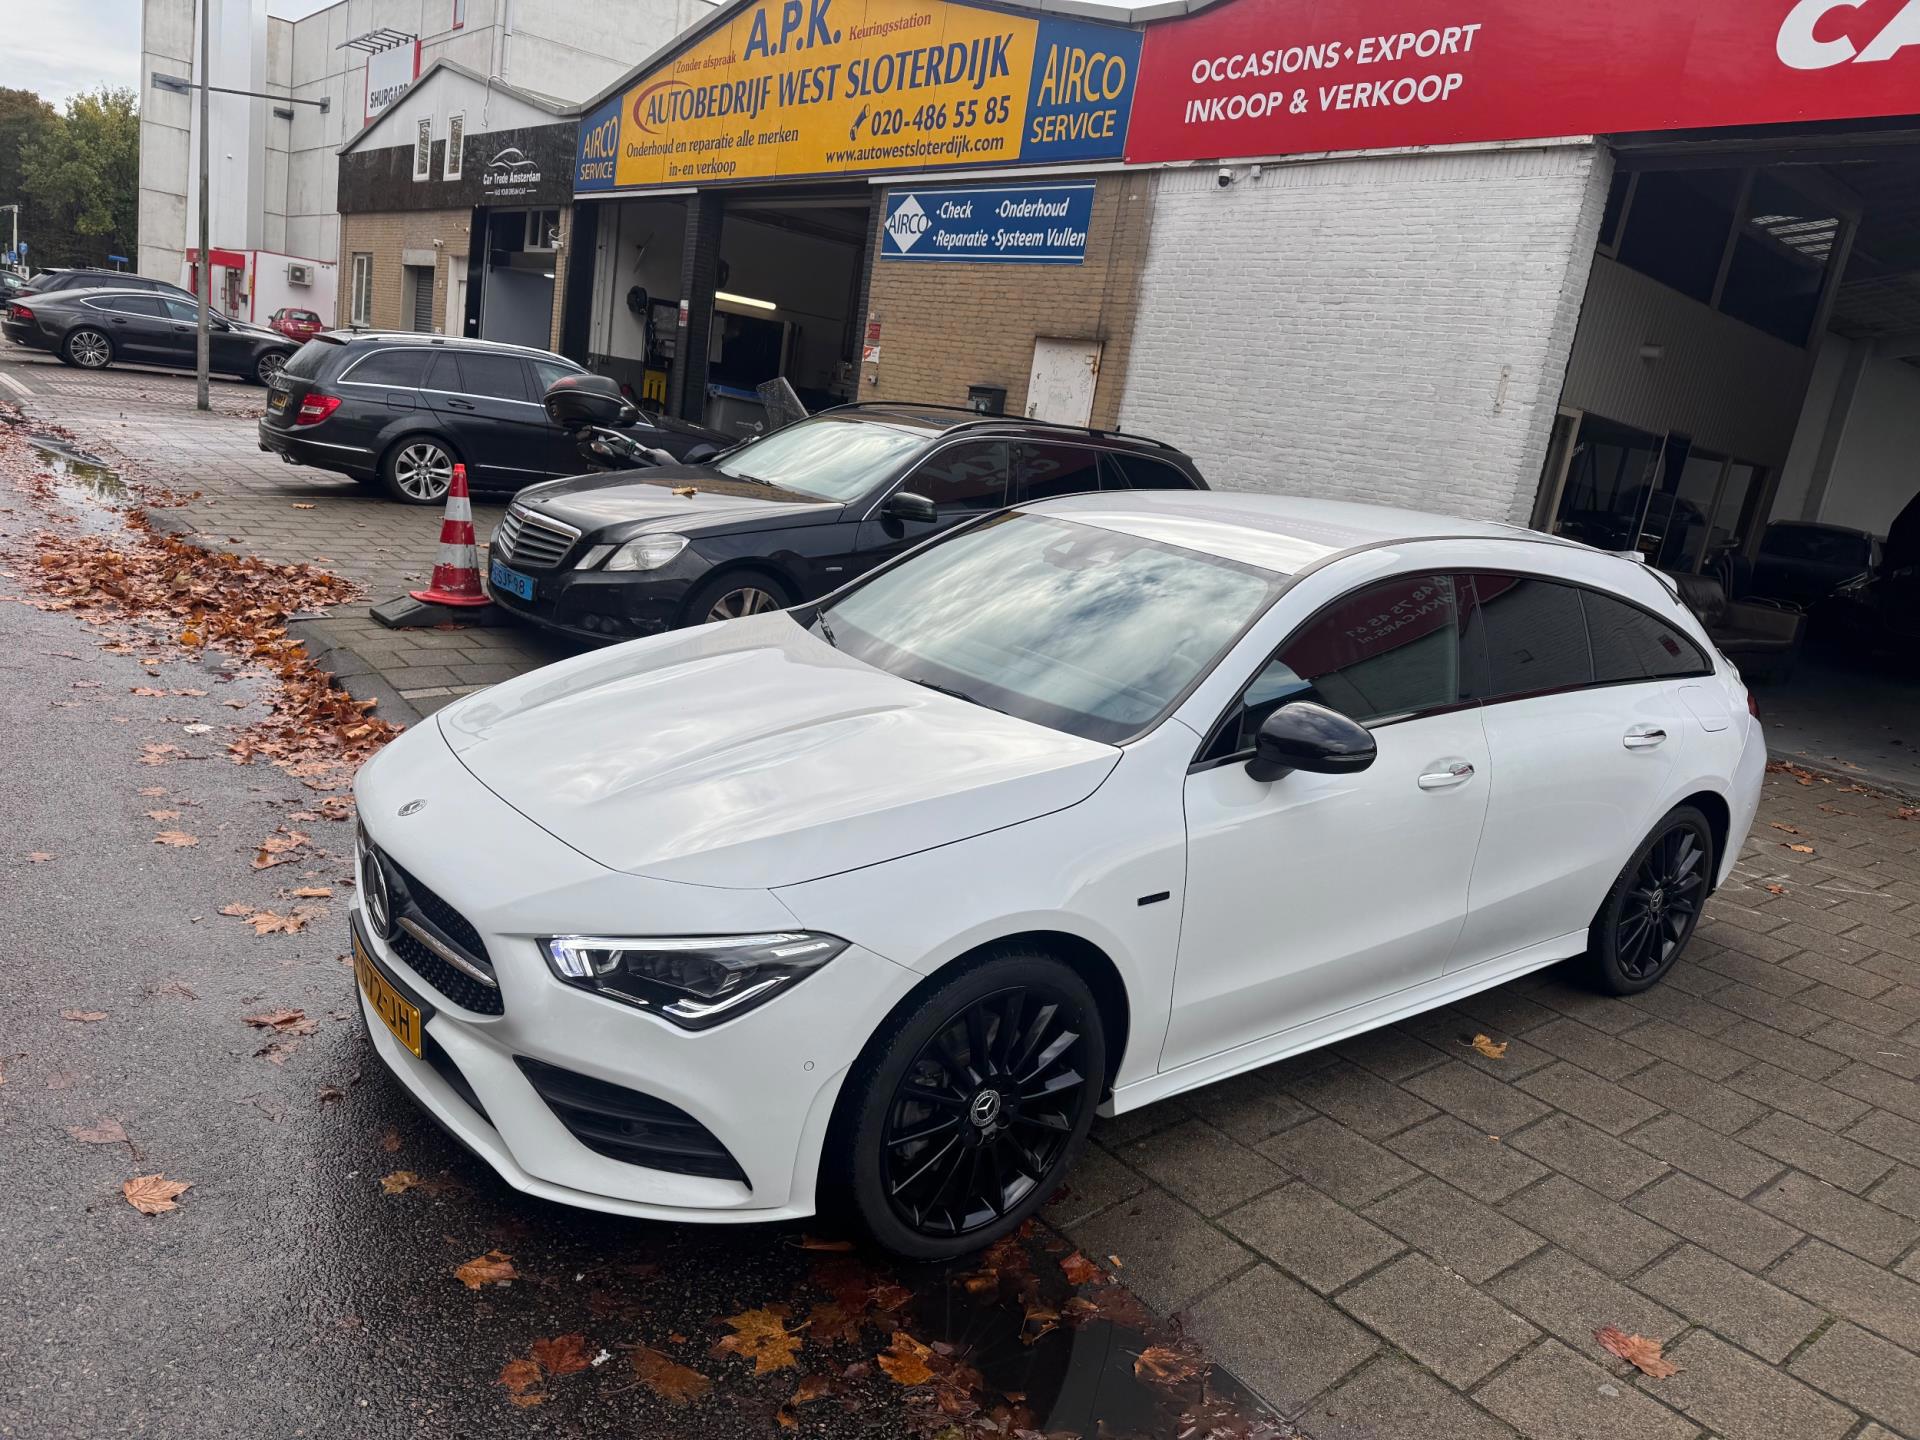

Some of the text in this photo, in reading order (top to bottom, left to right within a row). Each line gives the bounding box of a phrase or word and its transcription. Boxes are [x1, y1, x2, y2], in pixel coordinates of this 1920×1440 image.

[743, 0, 842, 61] A.P.K.
[849, 13, 932, 41] Keuringsstation
[676, 52, 737, 74] Zonder afspraak
[1191, 24, 1482, 84] OCCASIONS EXPORT
[645, 33, 1014, 126] AUTOBEDRIJF WEST SLOTERDIJK
[1036, 44, 1126, 107] AIRCO
[1184, 73, 1463, 124] INKOOP & VERKOOP
[871, 95, 1011, 137] 020-486 55 85
[1030, 110, 1117, 143] SERVICE
[583, 116, 618, 160] AIRCO
[627, 127, 799, 158] Onderhoud en reparatie alle merken
[826, 135, 1004, 164] www.autowestsloterdijk.com
[483, 170, 541, 185] Car Trade Amsterdam
[580, 161, 613, 181] SERVICE
[696, 157, 737, 177] verkoop
[888, 212, 929, 235] AIRCO
[936, 227, 1086, 251] Reparatie Systeem Vullen
